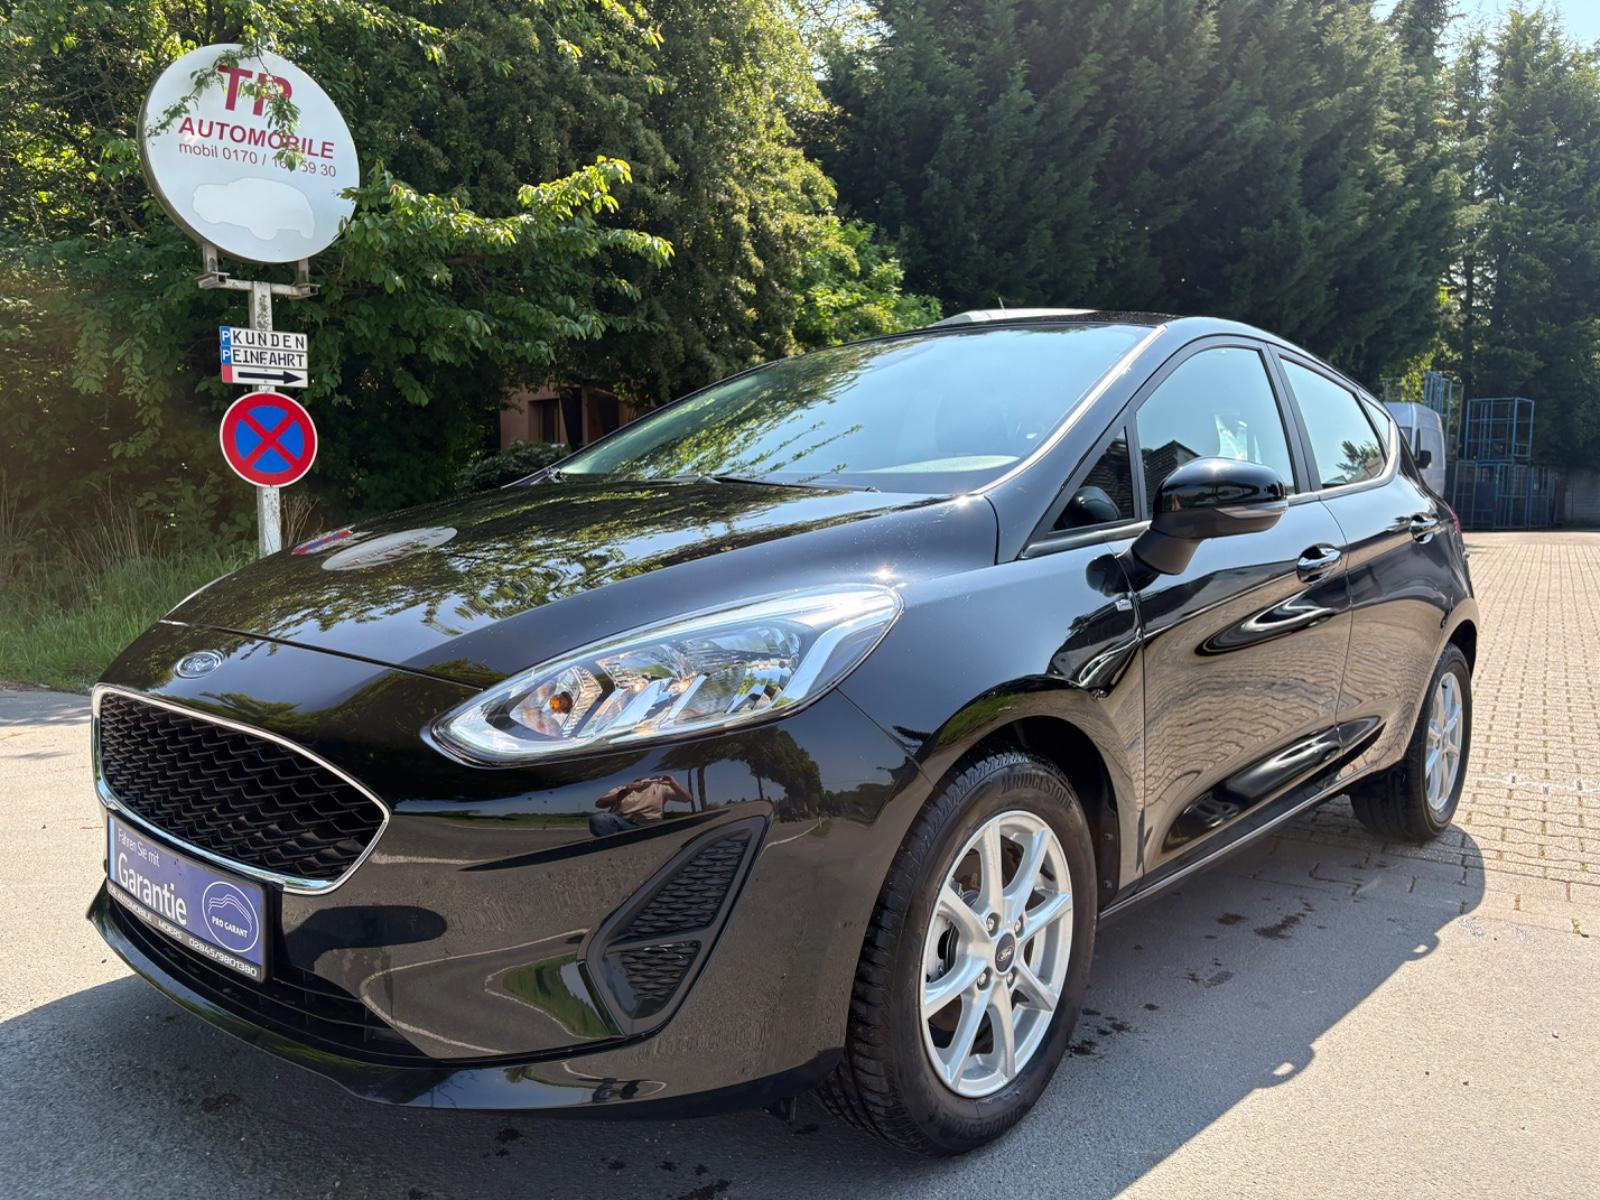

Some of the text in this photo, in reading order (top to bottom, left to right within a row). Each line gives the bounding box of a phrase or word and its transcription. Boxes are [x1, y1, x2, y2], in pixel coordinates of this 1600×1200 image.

[217, 64, 293, 116] TP
[178, 117, 335, 160] AUTOMOBILE
[179, 142, 218, 159] mobil
[222, 147, 258, 165] 0170
[320, 163, 337, 178] 30
[232, 330, 305, 350] KUNDEN
[232, 349, 305, 367] EINFAHRT
[137, 841, 148, 860] Sie
[148, 850, 160, 868] mit
[118, 852, 187, 926] Garantie
[211, 915, 248, 938] PRO GARANT
